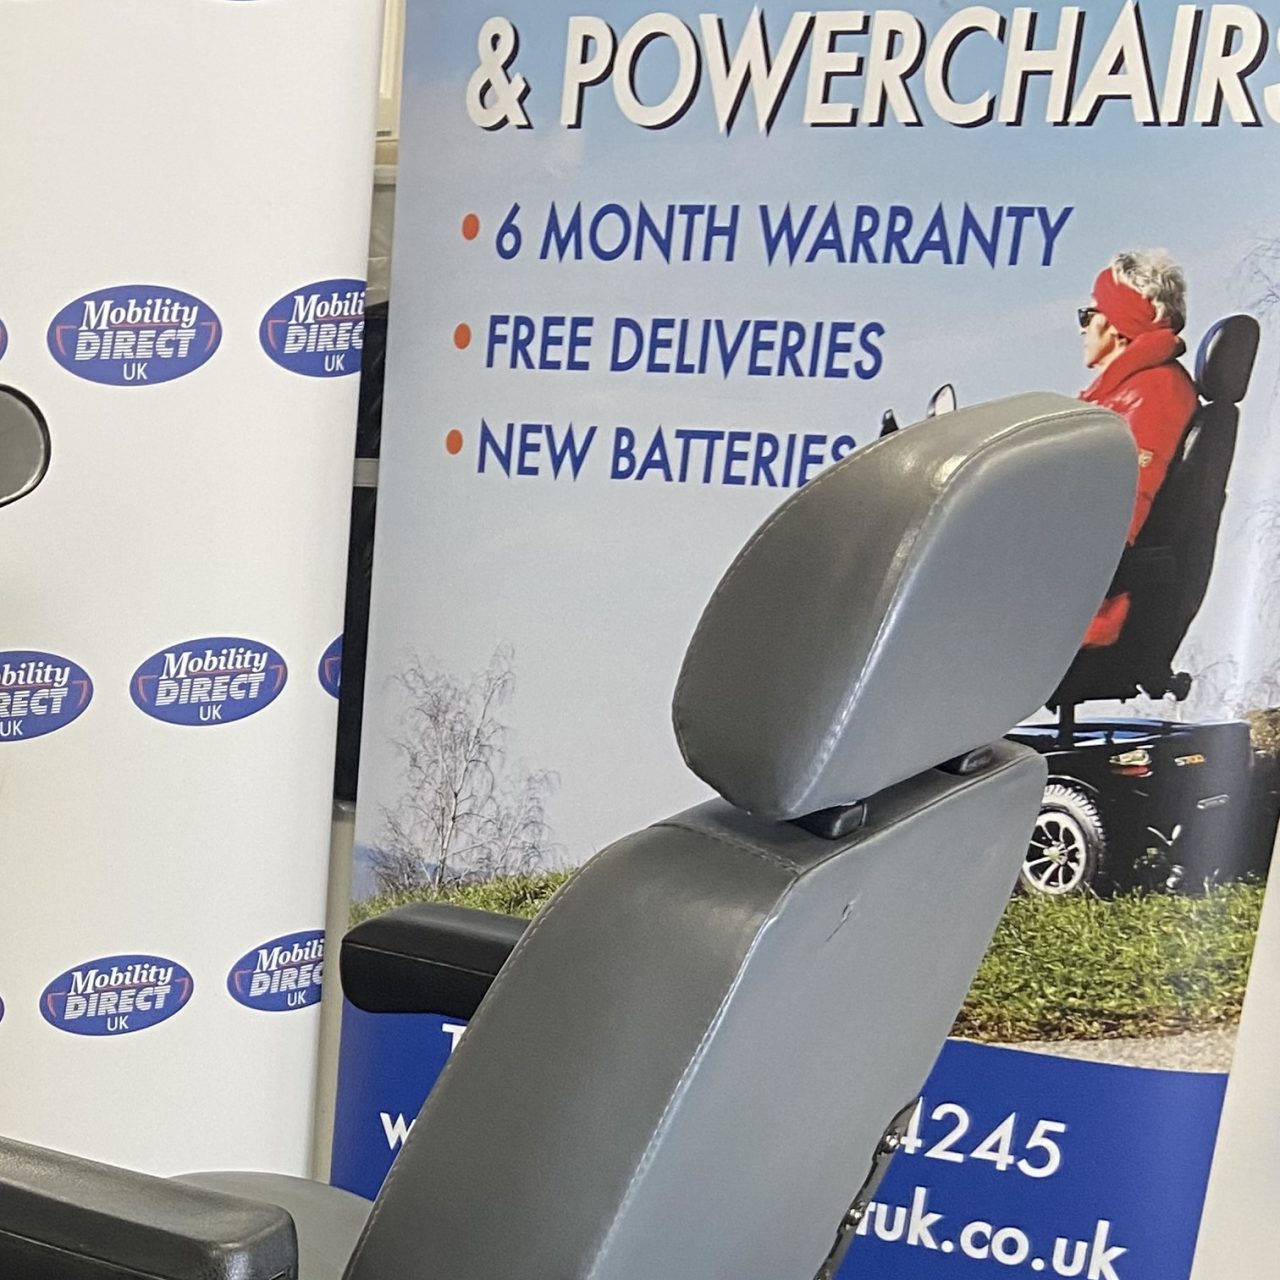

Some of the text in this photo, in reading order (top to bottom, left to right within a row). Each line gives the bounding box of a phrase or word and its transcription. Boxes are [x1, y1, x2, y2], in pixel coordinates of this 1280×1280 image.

[466, 1, 1280, 134] & POWERCHAIR
[495, 202, 1074, 268] 6 MONTH WARRANTY
[79, 298, 198, 332] Mobility
[288, 292, 365, 324] Mobili
[75, 328, 197, 361] DIRECT
[283, 321, 364, 354] DIREC
[485, 315, 885, 380] FREE DELIVERIES
[123, 362, 147, 381] UK
[324, 354, 345, 372] UK
[478, 419, 597, 480] NEW
[161, 648, 269, 682] Mobility
[154, 671, 265, 706] DIRECT
[199, 704, 223, 722] UK
[253, 939, 324, 973] Mobili
[68, 965, 175, 997] Mobility
[249, 962, 324, 997] DIREC
[64, 985, 171, 1020] DIRECT
[287, 990, 307, 1006] UK
[106, 1014, 130, 1032] UK
